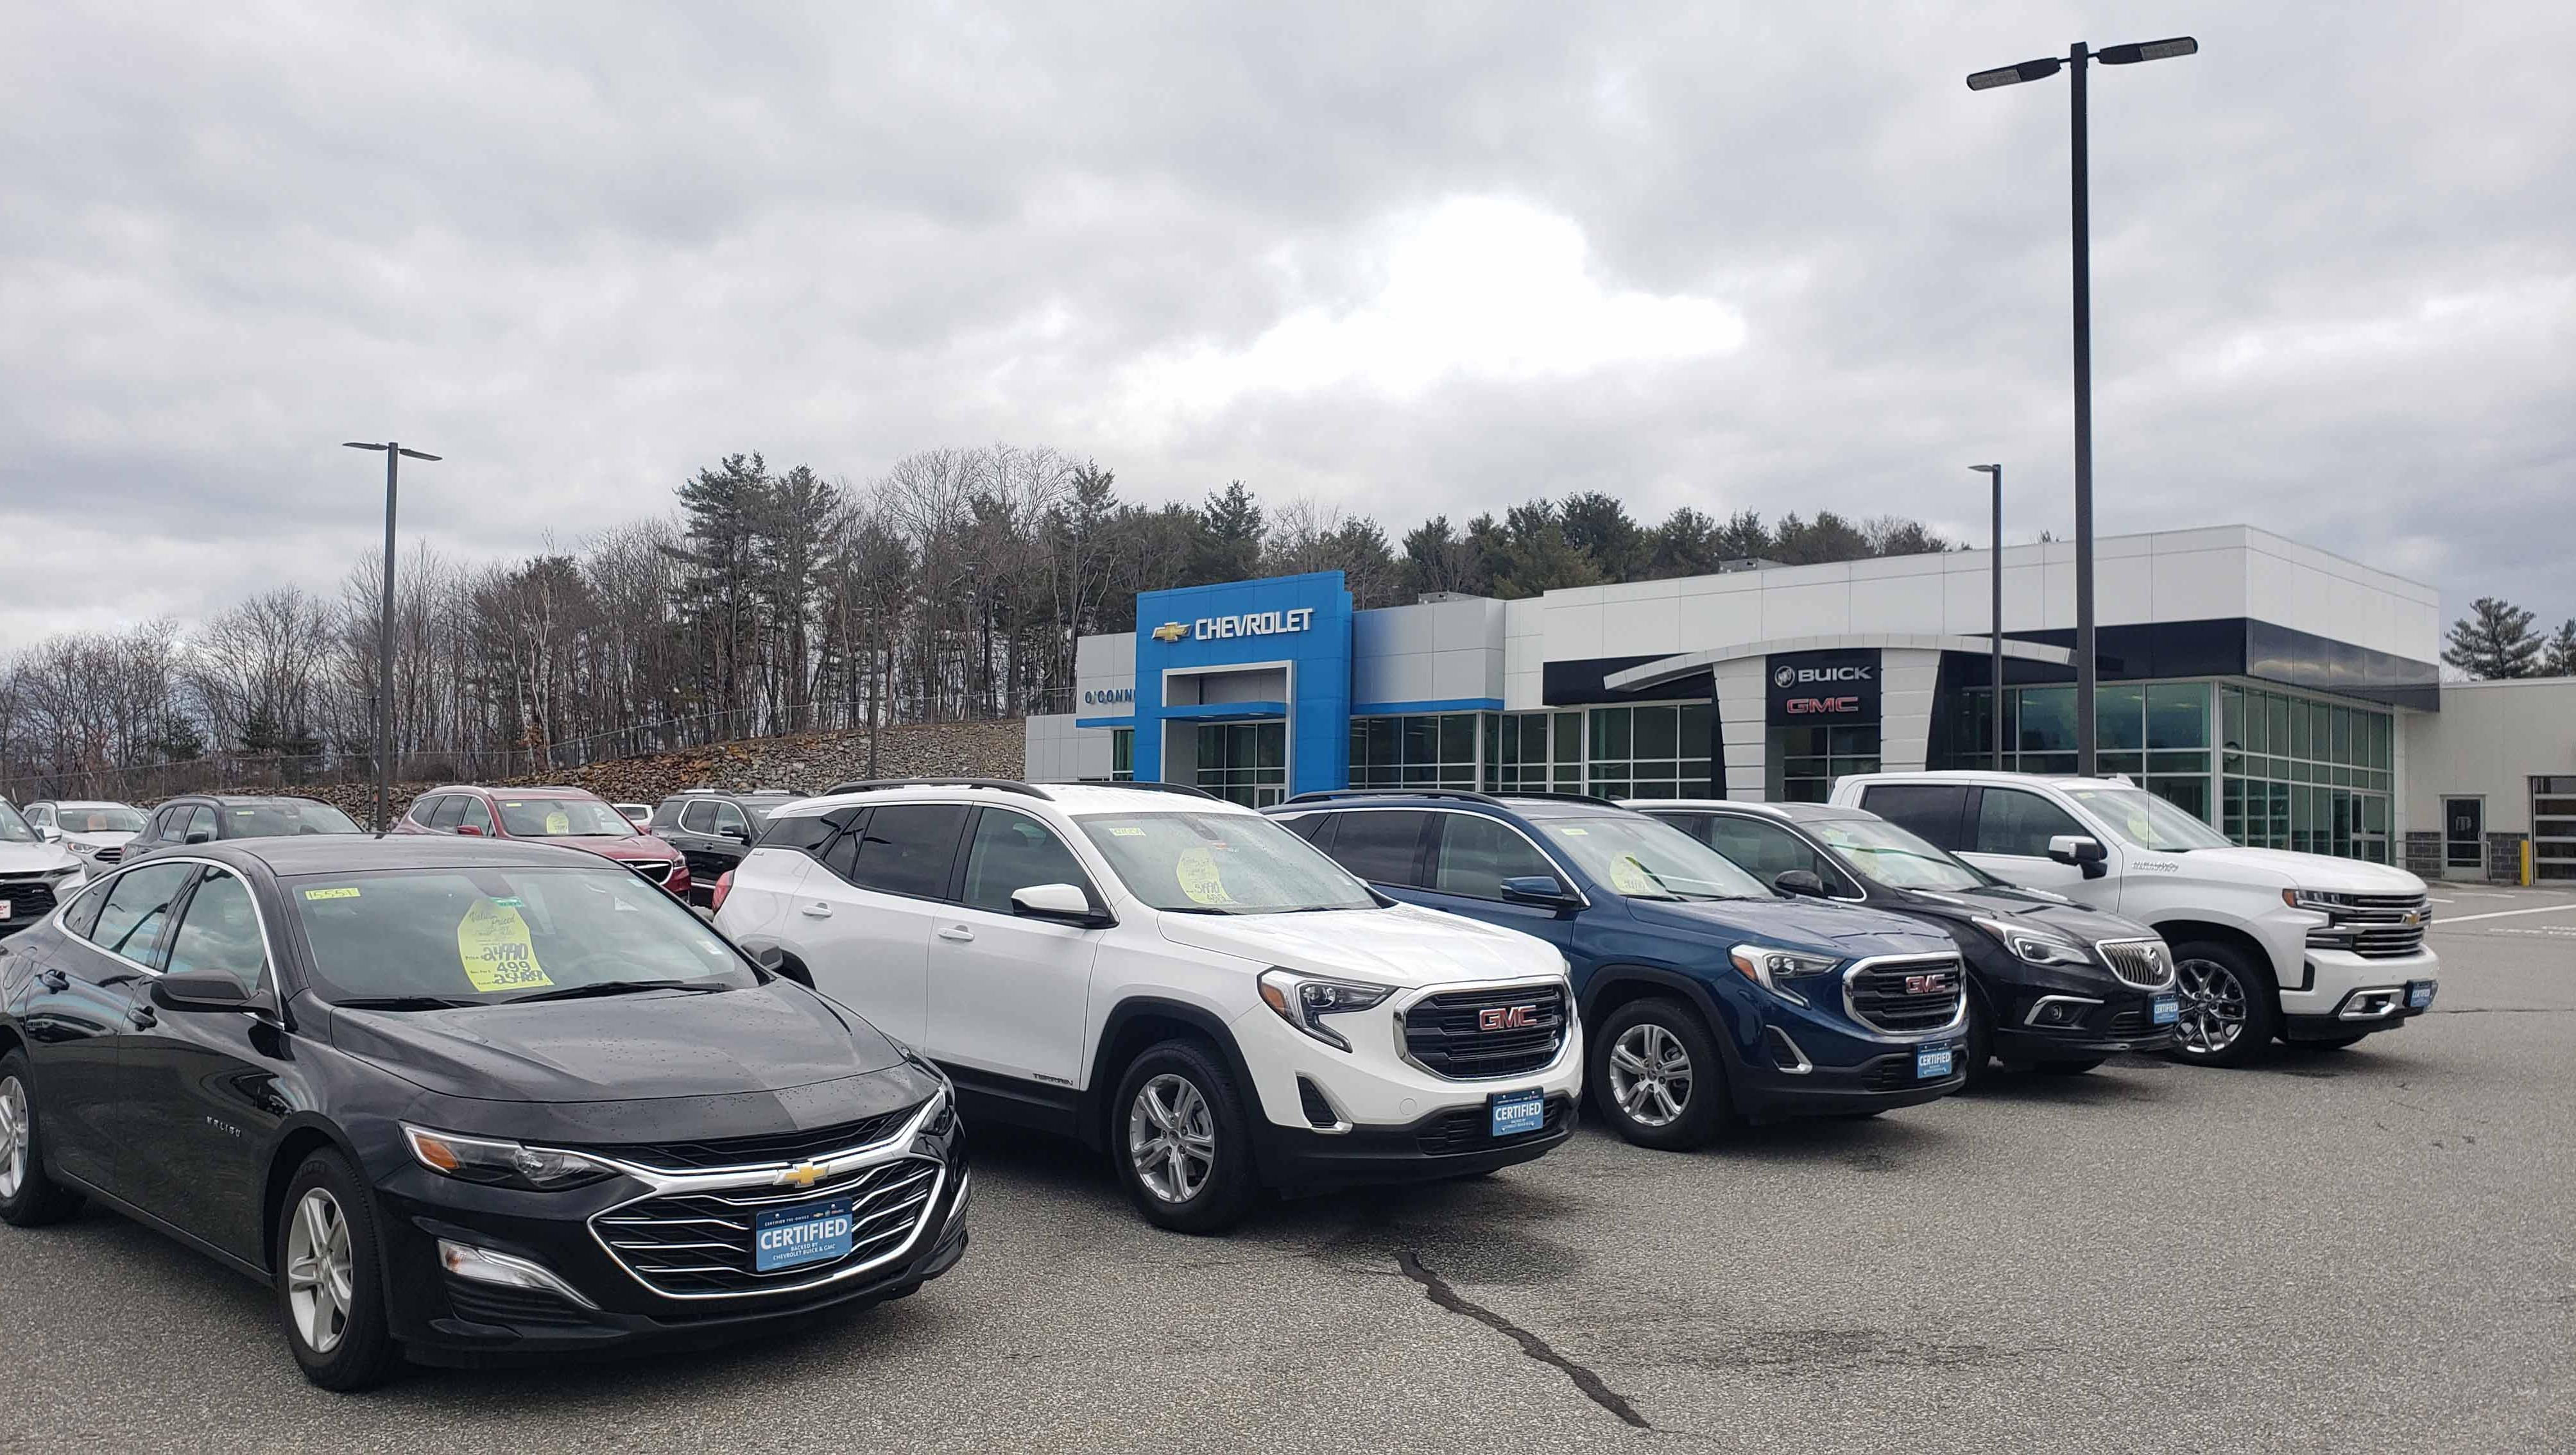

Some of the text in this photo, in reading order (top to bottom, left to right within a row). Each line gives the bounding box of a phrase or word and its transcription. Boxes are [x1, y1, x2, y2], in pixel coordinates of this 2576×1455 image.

[1196, 608, 1313, 640] CHEVROLET
[1798, 666, 1872, 683] BUICK
[1085, 688, 1135, 704] O'CONN
[1787, 697, 1859, 713] GMC
[1906, 974, 1945, 994] GMC
[1479, 1005, 1537, 1030] GMC
[1919, 1051, 1950, 1066] CERTIFIED
[1495, 1102, 1541, 1121] CERTIFIED
[760, 1218, 848, 1250] CERTIFIED
[773, 1250, 802, 1261] CHEVROLET
